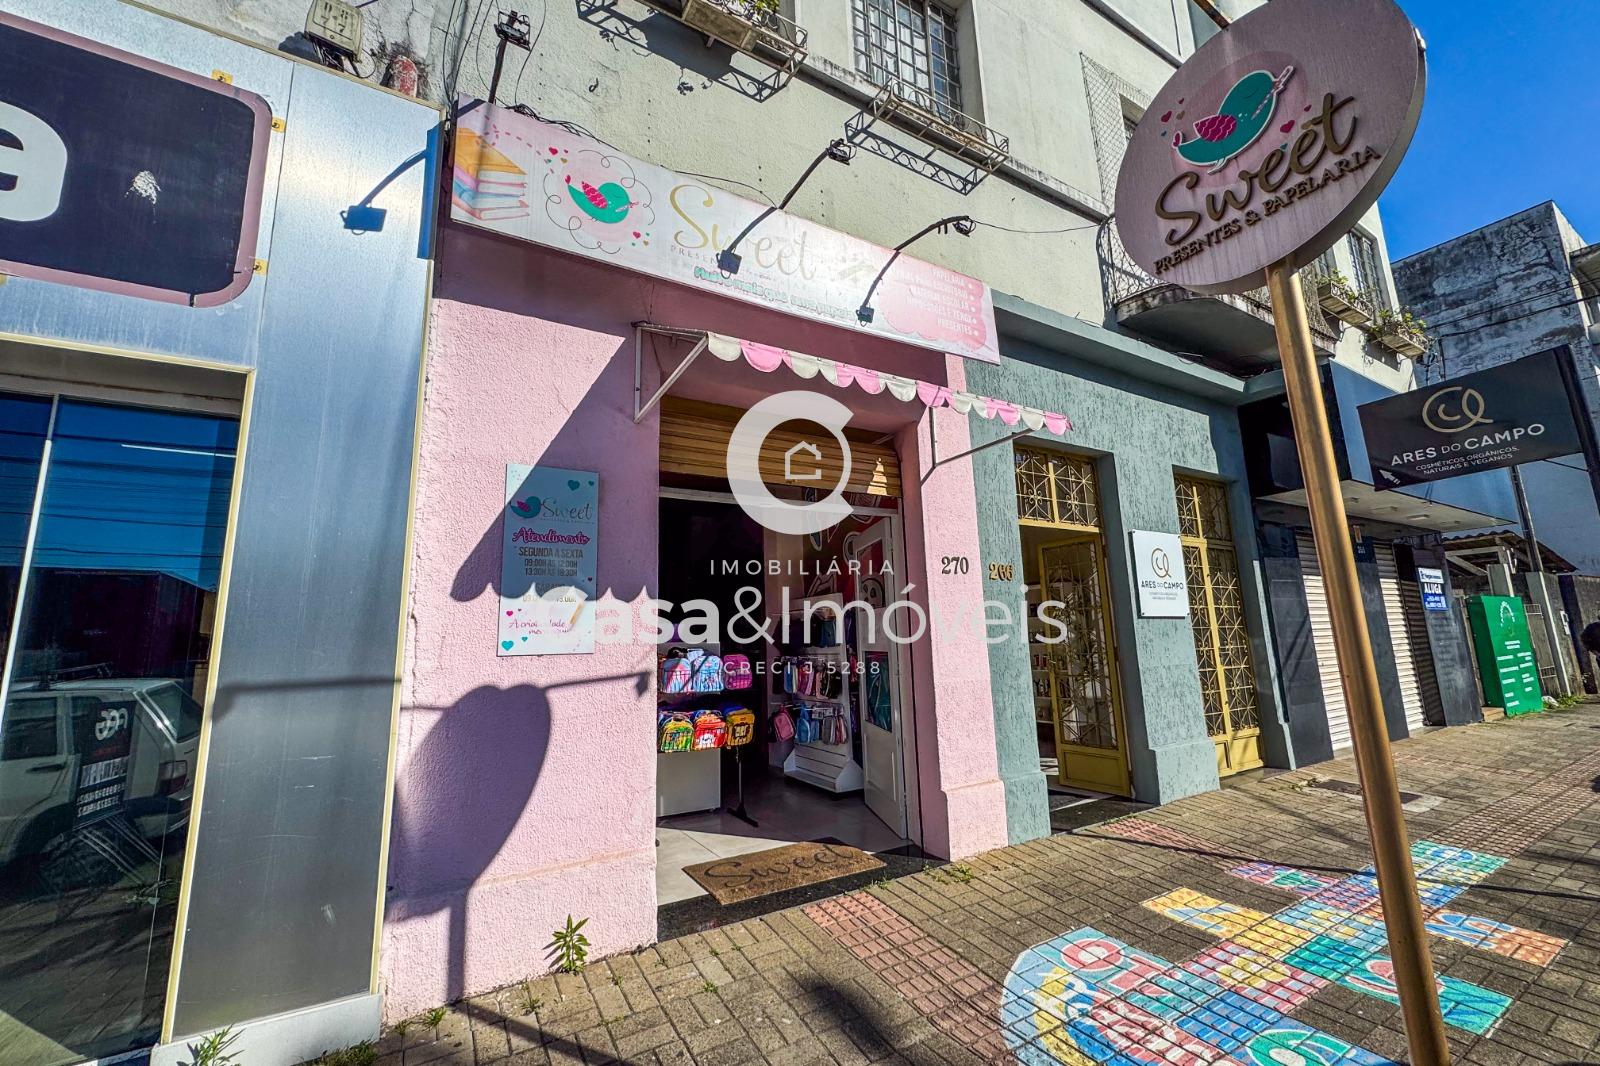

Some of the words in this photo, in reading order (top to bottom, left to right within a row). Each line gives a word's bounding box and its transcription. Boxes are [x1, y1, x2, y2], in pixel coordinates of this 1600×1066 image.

[1155, 92, 1357, 246] Sweet
[1153, 219, 1244, 275] PRESENTES
[1245, 209, 1261, 226] &
[1262, 144, 1382, 217] PAPELARIA
[1391, 447, 1437, 467] ARES
[1441, 442, 1461, 455] DO
[1464, 423, 1545, 450] CAMPO
[1471, 452, 1513, 467] VEGANOS
[541, 498, 593, 520] Sweet
[512, 527, 590, 545] Atendimento
[518, 546, 553, 558] SEGUNDA
[561, 548, 584, 559] SEXTA
[941, 556, 969, 575] 270
[989, 561, 1013, 581] 266
[1141, 580, 1157, 589] ARES
[1163, 581, 1184, 590] CAMPO
[1425, 583, 1442, 594] ALUGA
[704, 844, 853, 888] Sweet
